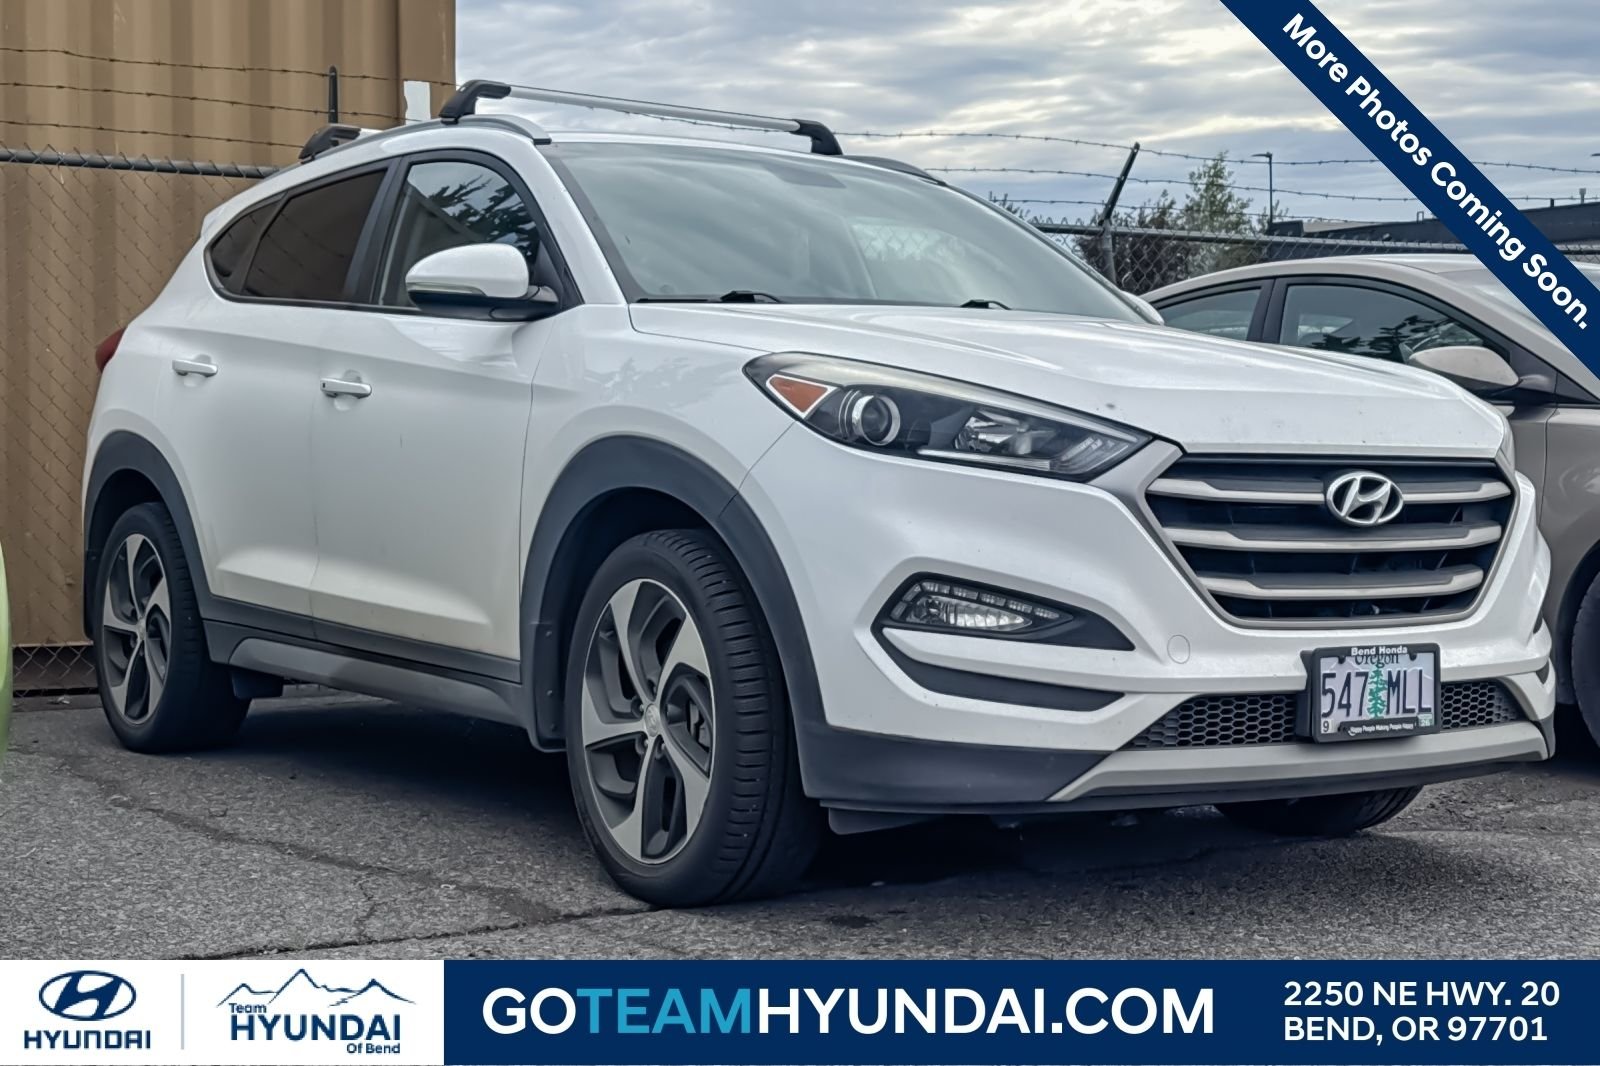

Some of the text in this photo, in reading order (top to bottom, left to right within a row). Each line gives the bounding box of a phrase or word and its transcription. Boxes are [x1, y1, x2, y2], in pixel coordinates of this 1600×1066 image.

[1351, 646, 1408, 656] Bend Honda
[1355, 654, 1399, 668] Oregon
[1321, 669, 1432, 718] 547 MLL
[1322, 720, 1330, 732] 9
